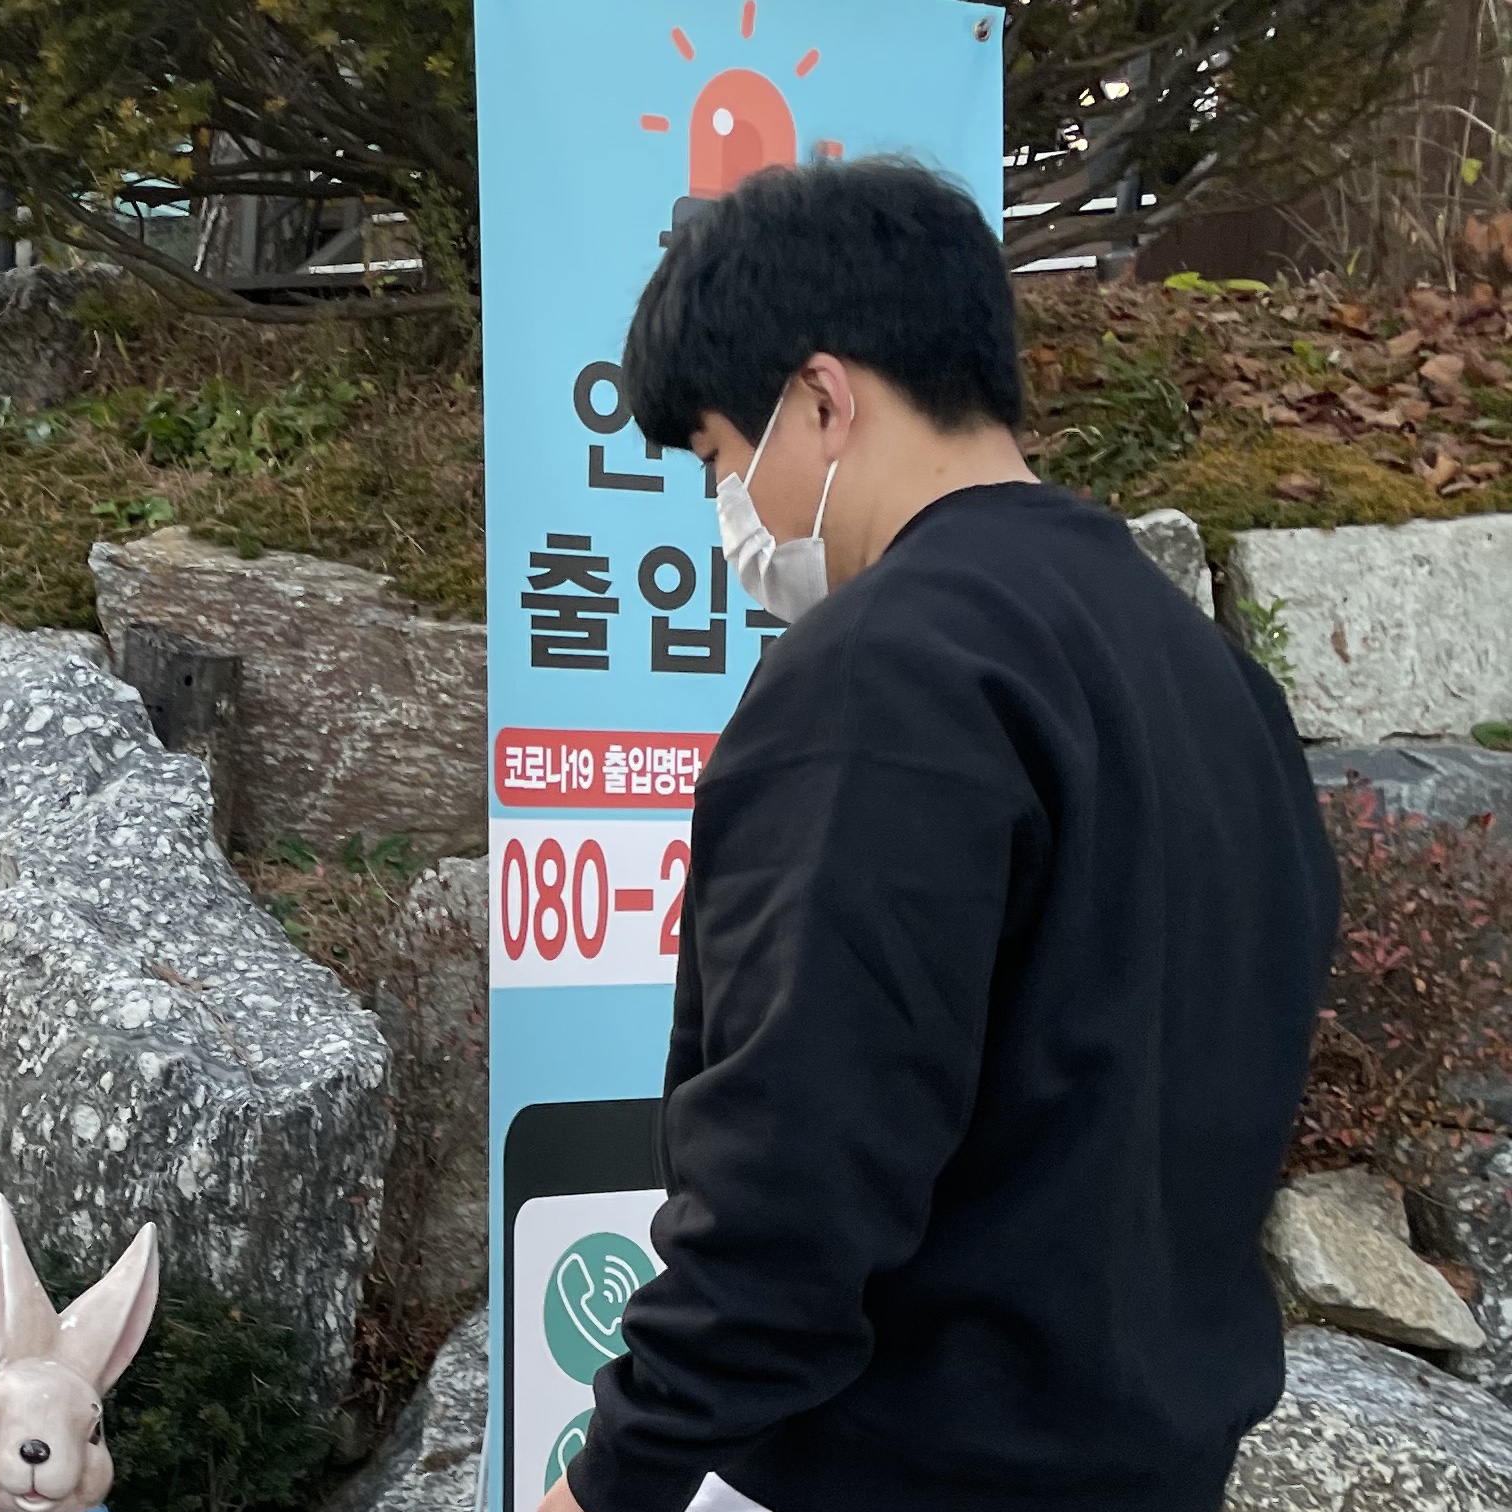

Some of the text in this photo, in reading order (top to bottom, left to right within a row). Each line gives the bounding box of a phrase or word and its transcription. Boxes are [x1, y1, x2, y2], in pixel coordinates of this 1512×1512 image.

[521, 532, 790, 675] 출입
[504, 744, 702, 795] 코로나19 출입명단
[501, 838, 691, 961] 080-2
